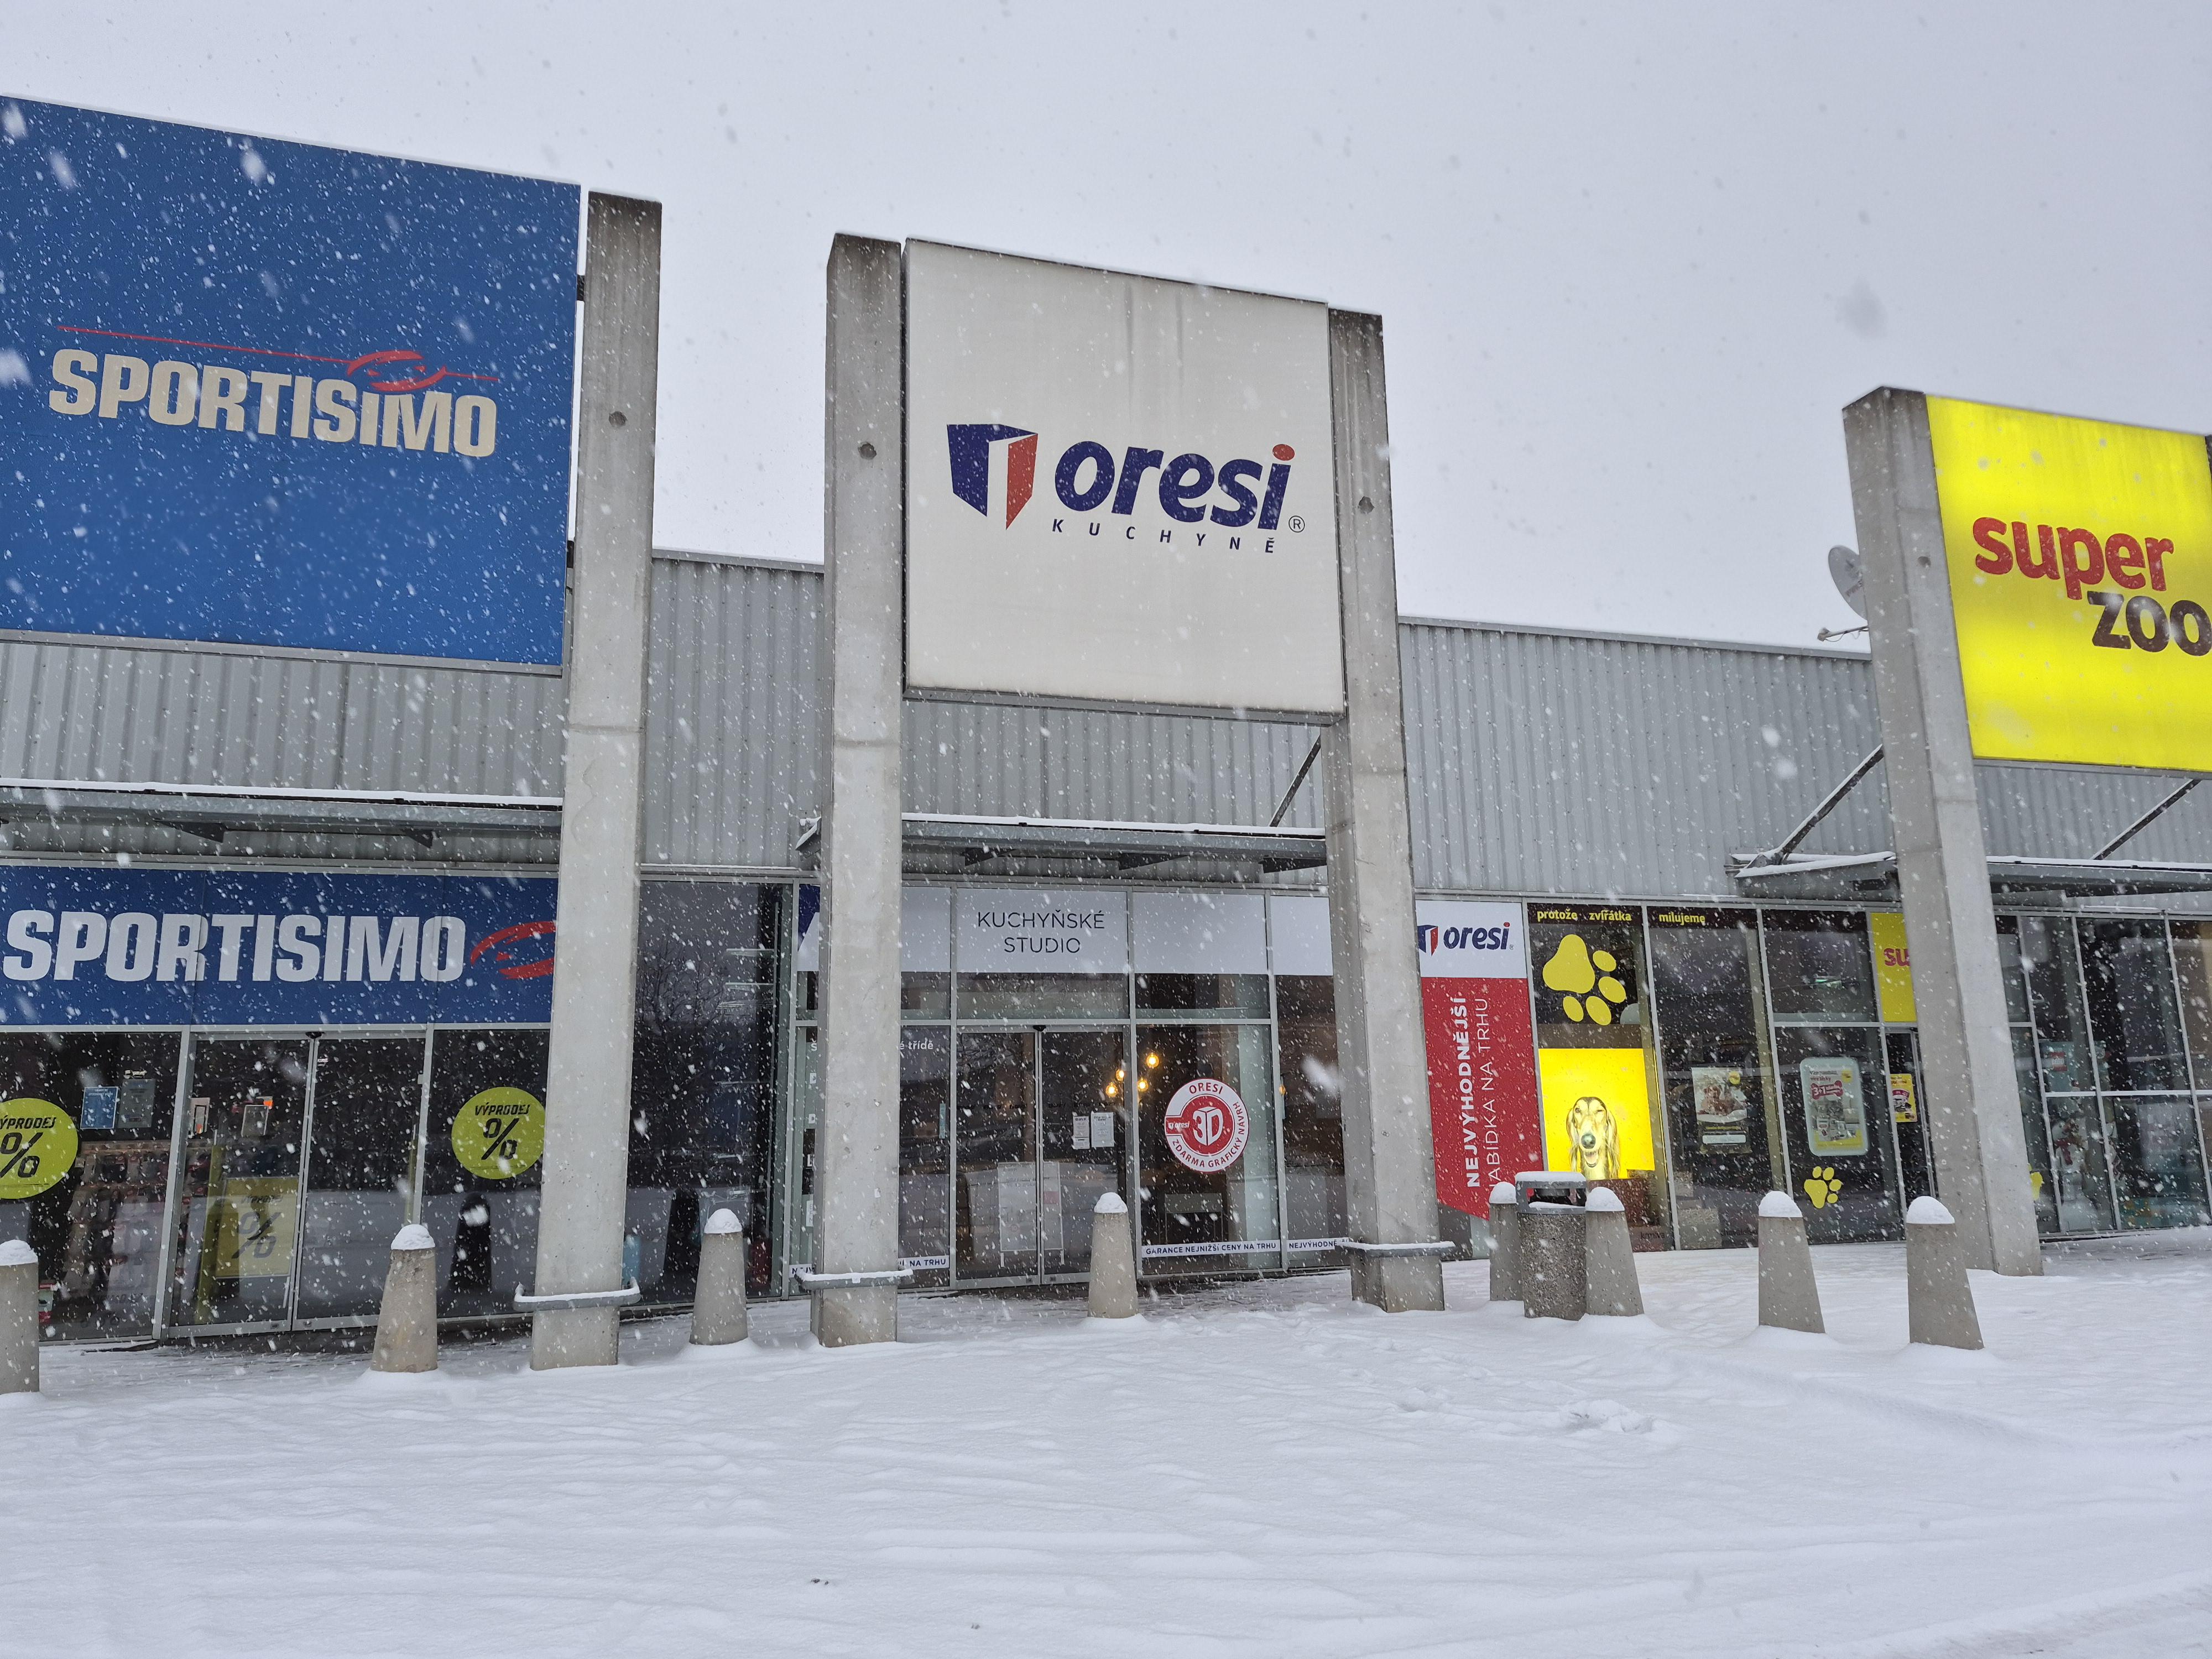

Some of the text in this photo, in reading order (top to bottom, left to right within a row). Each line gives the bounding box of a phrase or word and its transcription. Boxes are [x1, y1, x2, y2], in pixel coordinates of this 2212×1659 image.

[49, 348, 497, 457] SPORTISIMO
[1055, 440, 1295, 530] oresi
[1052, 518, 1275, 554] KUCHYNĚ
[1973, 517, 2174, 601] super
[2087, 590, 2212, 657] zoo
[978, 909, 1105, 930] KUCHYŇSKÉ
[1537, 908, 1705, 926] protože zvířátka milujeme
[3, 910, 466, 982] SPORTISIMO
[1003, 936, 1081, 954] STUDIO
[1443, 922, 1510, 950] oresi
[1884, 947, 1912, 967] su
[1474, 998, 1491, 1053] TRHU
[908, 1037, 934, 1050] třídě
[1189, 1082, 1223, 1094] ORESI
[1480, 1061, 1495, 1091] NA
[1450, 998, 1481, 1188] NEJVÝHODNĚJŠÍ
[0, 1115, 56, 1130] ÝPRODEJ
[475, 1102, 530, 1116] VÝPRODEJ
[1172, 1102, 1245, 1167] ZDARMA GRAFICKÝ NÁVRH
[1192, 1106, 1224, 1146] 3D
[1146, 1246, 1183, 1255] GARANCE
[1185, 1244, 1219, 1253] NEJNIŽŠÍ
[1289, 1239, 1348, 1249] NEJVÝHODNĚ
